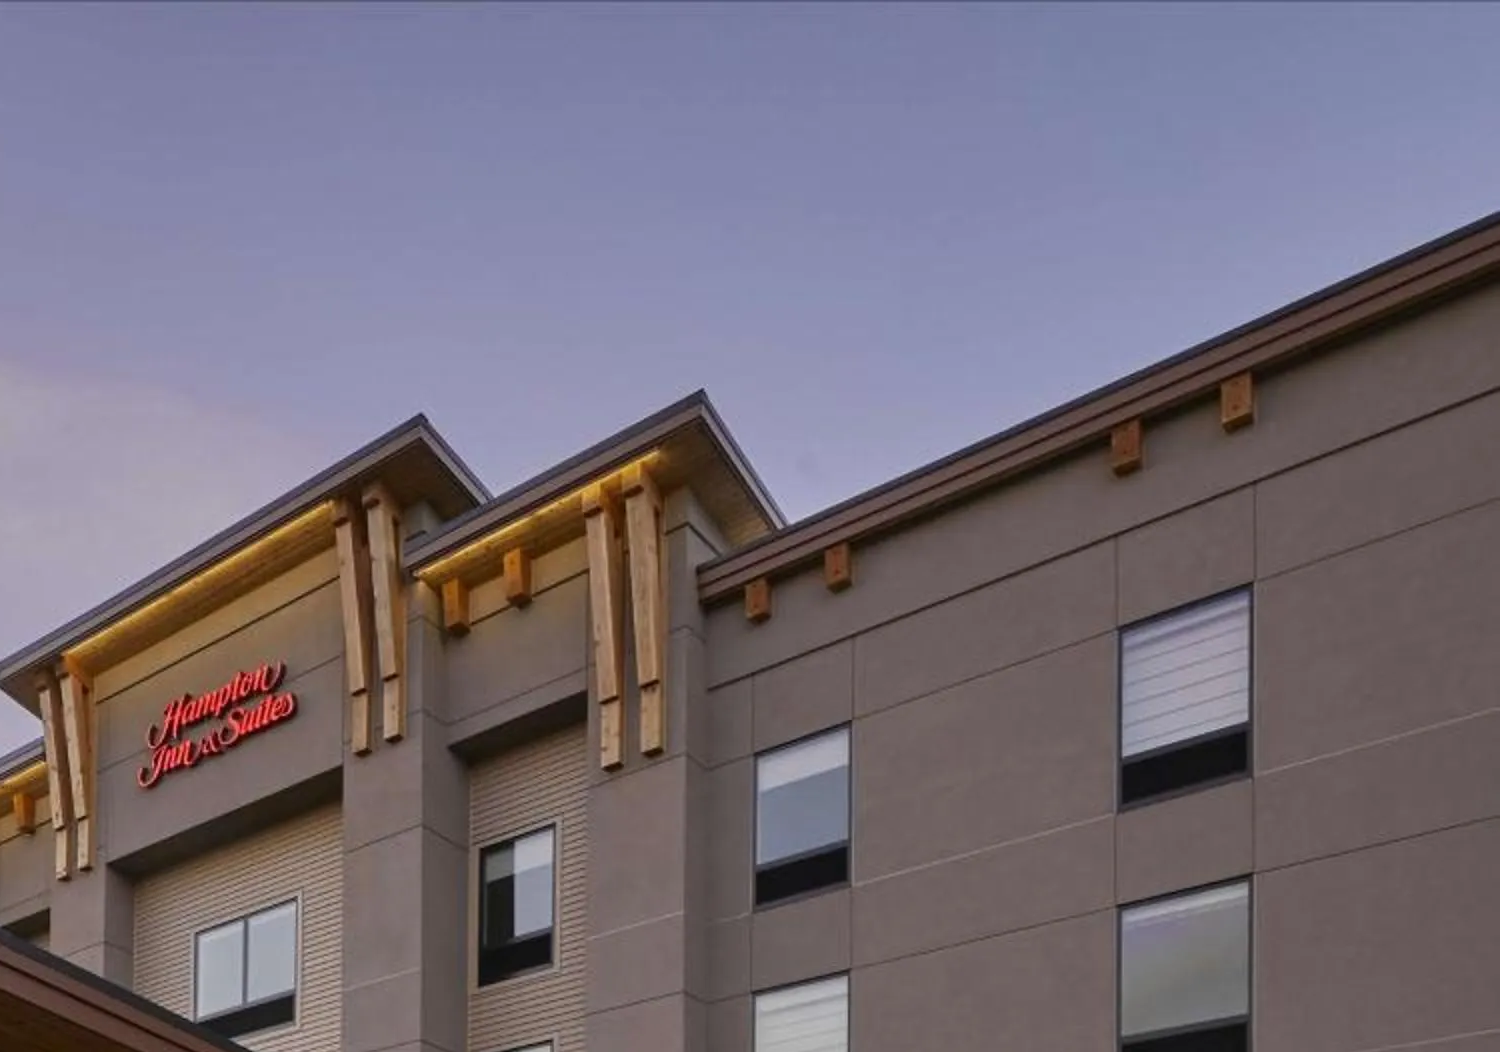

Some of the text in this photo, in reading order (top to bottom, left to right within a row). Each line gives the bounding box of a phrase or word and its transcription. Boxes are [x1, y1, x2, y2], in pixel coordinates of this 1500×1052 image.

[136, 739, 199, 789] Inn
[218, 692, 298, 745] Suites
[147, 660, 286, 749] Hampton
